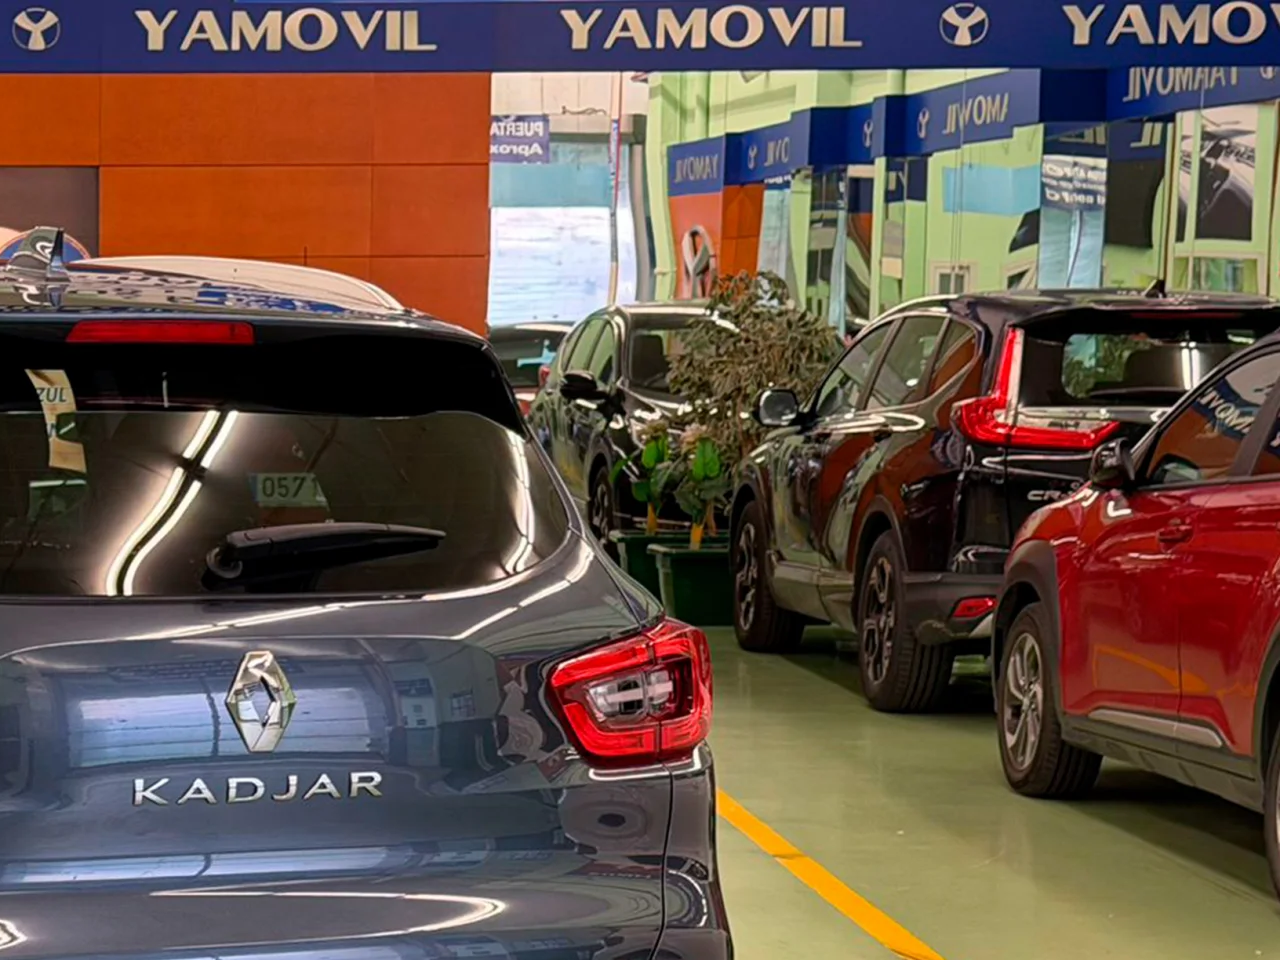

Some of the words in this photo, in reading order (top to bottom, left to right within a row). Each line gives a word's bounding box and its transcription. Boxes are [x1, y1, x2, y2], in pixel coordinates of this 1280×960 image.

[134, 7, 438, 52] YAMOVIL
[559, 4, 863, 50] YAMOVIL
[1061, 0, 1280, 46] YAMO
[132, 769, 384, 807] KADJAR
